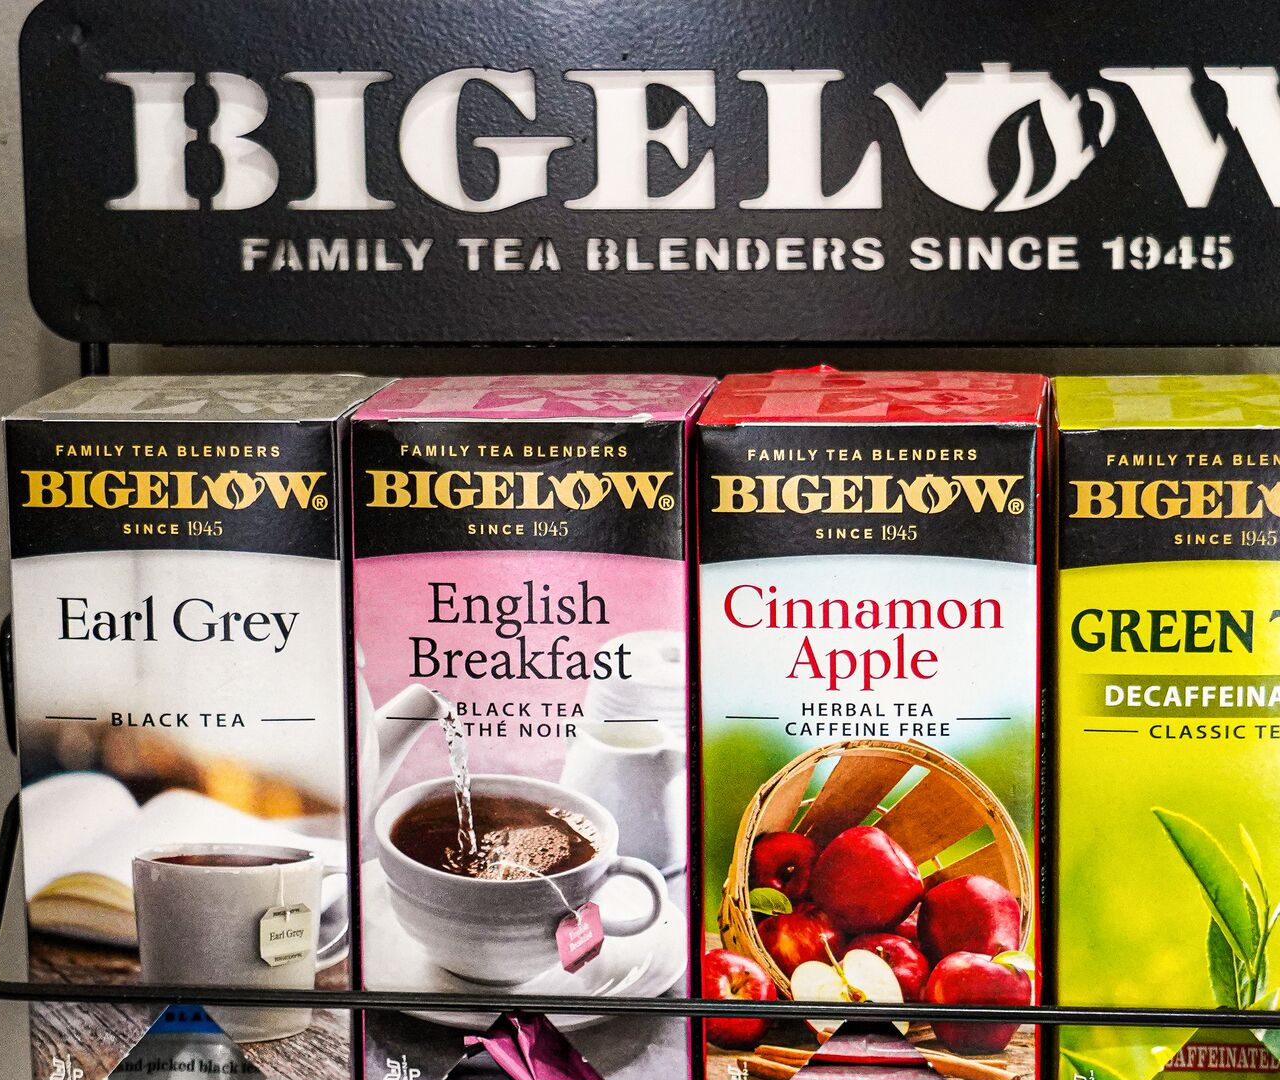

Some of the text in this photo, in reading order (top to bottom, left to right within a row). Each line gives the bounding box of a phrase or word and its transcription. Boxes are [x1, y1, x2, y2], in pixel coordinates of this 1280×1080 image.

[243, 236, 1233, 271] FAMILY TEA BLENDERS SINCE 1945
[56, 445, 279, 457] FAMILY TEA BLENDERS
[401, 445, 627, 457] FAMILY TEA BLENDERS
[748, 449, 976, 461] FAMILY TEA BLENDERS
[1107, 455, 1177, 466] FAMILY
[1186, 455, 1222, 465] TEA
[124, 521, 222, 536] SINCE 1945
[469, 521, 568, 536] SINCE 1945
[816, 525, 917, 540] SINCE 1945
[1175, 530, 1277, 546] SINCE 1945
[427, 579, 610, 637] English
[724, 586, 1001, 629] Cinnamon
[57, 596, 299, 653] Earl Grey
[1071, 609, 1253, 653] GREEN
[408, 635, 632, 681] Breakfast
[789, 634, 937, 691] Apple
[457, 702, 584, 716] BLACK TEA
[802, 703, 933, 716] HERBAL TEA
[111, 713, 244, 727] BLACK TEA
[464, 720, 576, 737] THÉ NOIR
[785, 722, 949, 736] CAFFEINE FREE
[1150, 725, 1245, 739] CLASSIC
[199, 1059, 239, 1074] black
